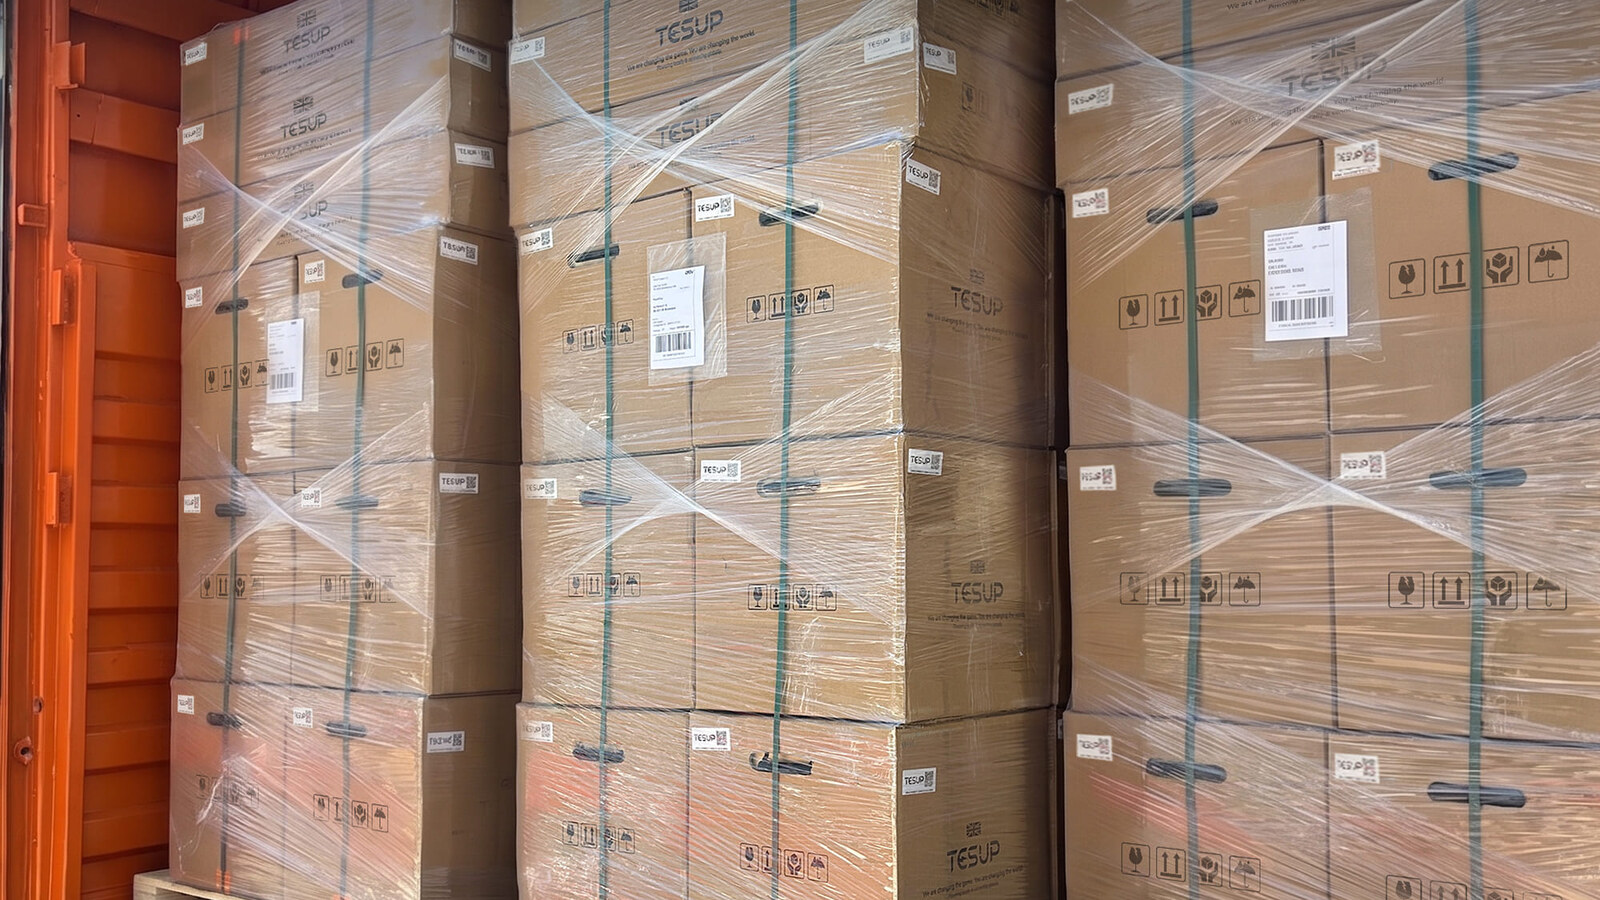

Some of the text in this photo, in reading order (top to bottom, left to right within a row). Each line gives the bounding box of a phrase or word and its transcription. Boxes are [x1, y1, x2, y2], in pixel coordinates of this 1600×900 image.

[655, 9, 724, 47] TESUP
[283, 25, 331, 53] TESUP
[868, 38, 891, 48] TESUP
[280, 113, 327, 138] TESUP
[908, 165, 929, 180] TESUP
[697, 202, 720, 212] TESUP
[950, 285, 1004, 317] TESUP
[911, 455, 931, 465] TESUP
[703, 465, 727, 474] TESUP
[442, 477, 465, 486] TESUP
[950, 581, 1004, 604] TESUP
[694, 734, 716, 742] TESUP
[904, 775, 925, 785] TESUP
[946, 840, 1000, 873] TESUP
